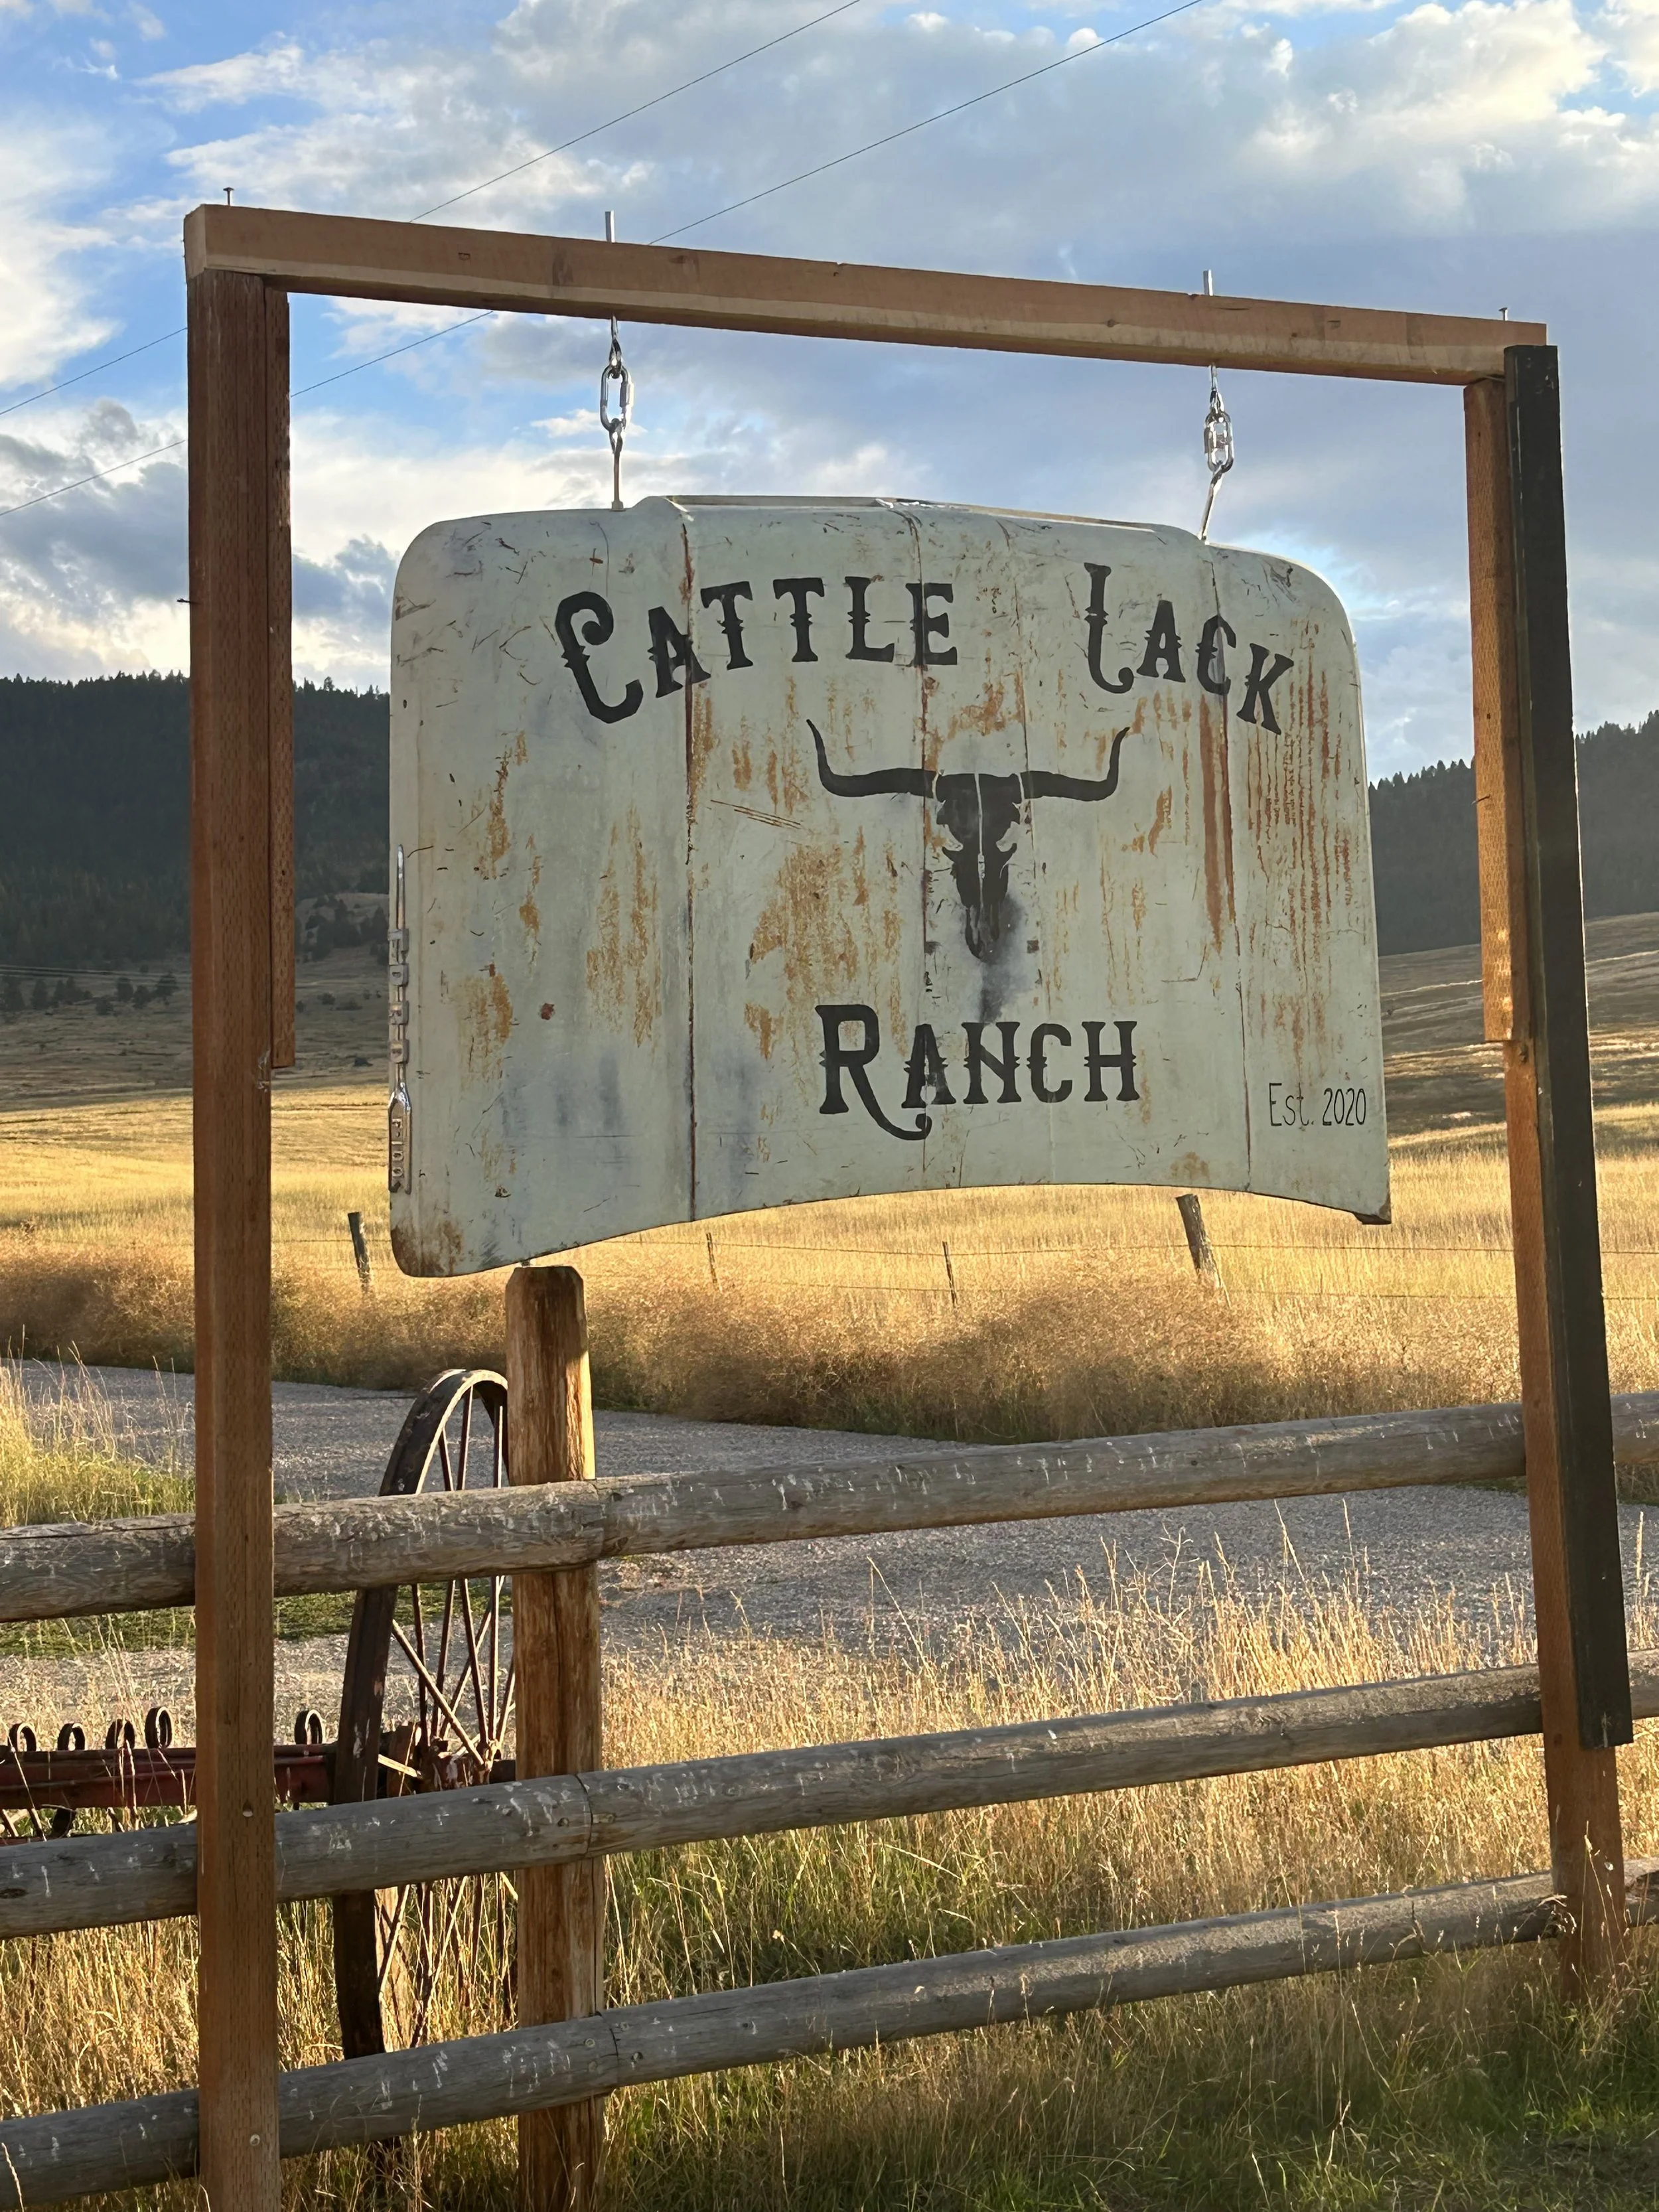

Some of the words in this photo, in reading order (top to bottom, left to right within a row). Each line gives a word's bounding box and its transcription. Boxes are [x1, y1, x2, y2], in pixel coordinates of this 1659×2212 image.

[555, 576, 957, 723] CATTLE
[815, 1004, 1140, 1140] RANCH
[1269, 1082, 1314, 1126] Est.
[1323, 1088, 1366, 1126] 2020
